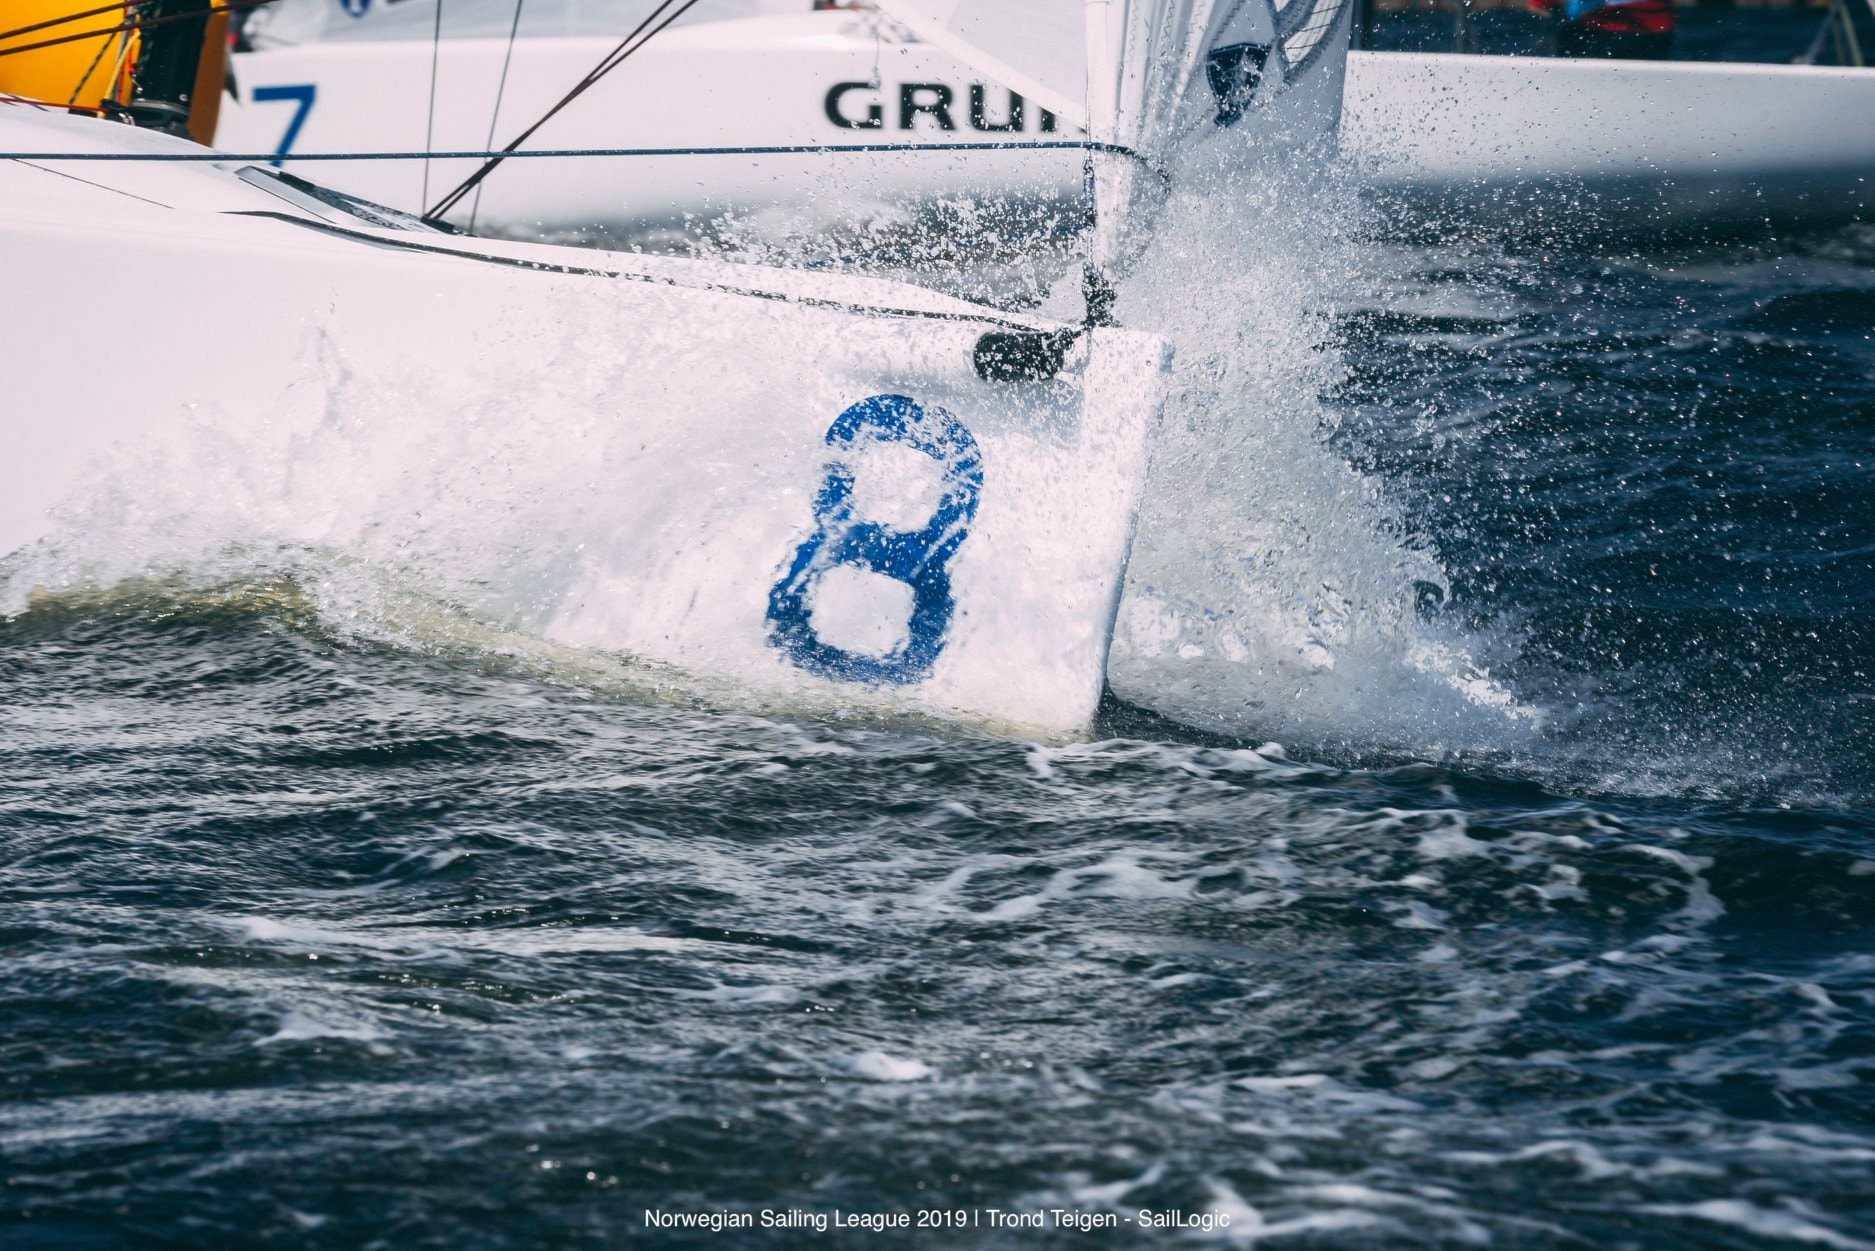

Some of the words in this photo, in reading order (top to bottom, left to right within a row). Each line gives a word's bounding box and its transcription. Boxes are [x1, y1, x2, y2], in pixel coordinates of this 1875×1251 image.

[252, 84, 317, 167] 7
[824, 81, 1057, 132] GRU
[764, 394, 983, 687] 8
